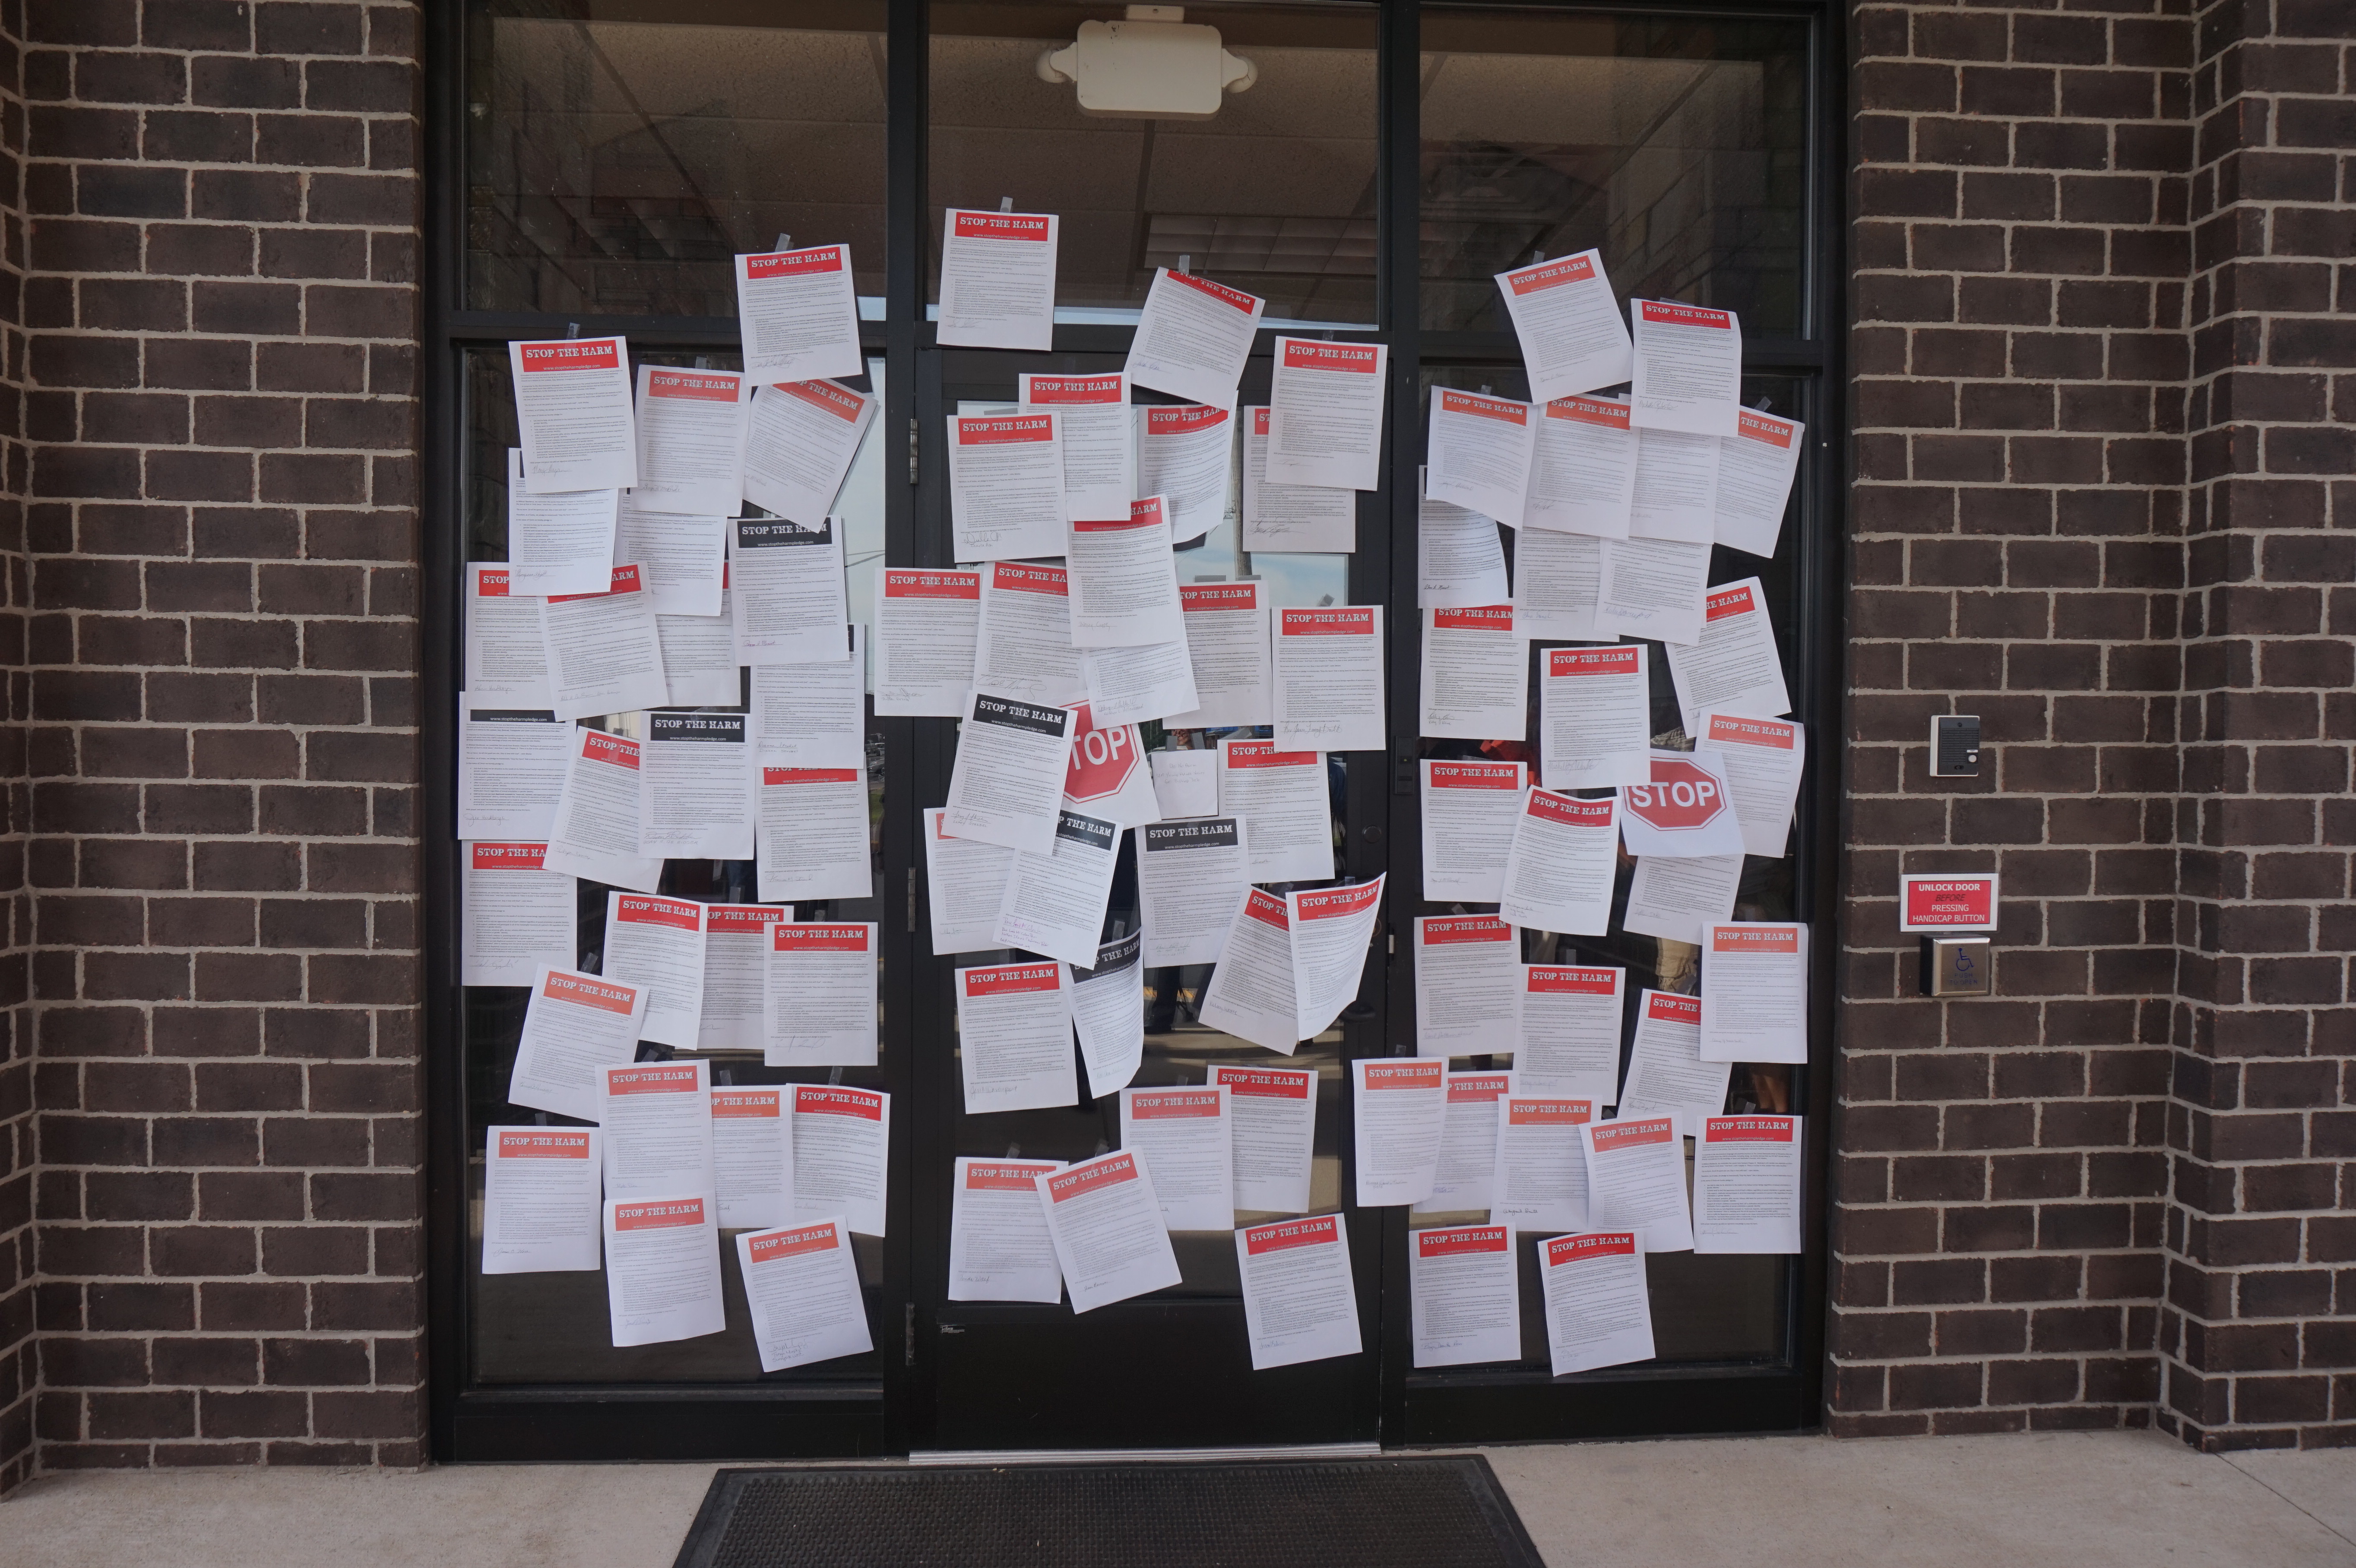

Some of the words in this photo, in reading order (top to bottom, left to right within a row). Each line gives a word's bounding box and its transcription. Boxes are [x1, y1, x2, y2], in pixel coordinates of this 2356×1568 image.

[960, 217, 987, 226] STOP
[989, 219, 1010, 228] THE
[1012, 220, 1044, 229] HARM
[751, 258, 778, 268] STOP
[780, 256, 802, 265] THE
[804, 252, 836, 262] HARM
[1513, 274, 1536, 285] STOP
[1538, 268, 1558, 278] THE
[1558, 261, 1588, 274] HARM
[526, 349, 554, 358] STOP
[557, 348, 580, 357] THE
[581, 345, 613, 356] HARM
[1289, 345, 1315, 356] STOP
[1317, 348, 1339, 358] THE
[1341, 350, 1373, 360] HARM
[654, 376, 680, 386] STOP
[682, 379, 703, 388] THE
[705, 380, 735, 389] HARM
[1034, 382, 1061, 391] STOP
[1063, 382, 1085, 392] THE
[1087, 381, 1117, 391] HARM
[1446, 395, 1471, 405] STOP
[1472, 400, 1492, 409] THE
[1494, 405, 1523, 415] HARM
[963, 423, 989, 431] STOP
[991, 422, 1013, 431] THE
[1015, 420, 1047, 430] HARM
[742, 526, 769, 535] STOP
[771, 525, 793, 534] THE
[890, 575, 917, 584] STOP
[919, 576, 940, 585] THE
[943, 577, 975, 586] HARM
[1286, 614, 1312, 623] STOP
[1314, 614, 1335, 623] THE
[1337, 613, 1369, 622] HARM
[1553, 655, 1577, 664] STOP
[1579, 654, 1600, 663] THE
[1602, 652, 1634, 662] HARM
[979, 700, 1006, 712] STOP
[1008, 705, 1029, 718] THE
[1031, 710, 1062, 724] HARM
[655, 719, 682, 728] STOP
[684, 720, 706, 729] THE
[709, 721, 741, 730] HARM
[991, 719, 1047, 733] www.stoptheharmpledge.com
[1713, 720, 1738, 730] STOP
[1741, 723, 1760, 733] THE
[1761, 726, 1790, 737] HARM
[1071, 726, 1126, 770] TOP
[1434, 767, 1459, 775] STOP
[1461, 768, 1481, 776] THE
[1483, 768, 1514, 777] HARM
[1632, 781, 1715, 807] STOP
[1533, 796, 1558, 808] STOP
[1560, 803, 1580, 814] THE
[1581, 806, 1610, 815] HARM
[1543, 815, 1596, 826] www.stoptheharmpledge.com
[1149, 828, 1175, 838] STOP
[1178, 827, 1199, 836] THE
[1200, 824, 1232, 835] HARM
[1302, 897, 1328, 907] STOP
[1331, 894, 1352, 904] THE
[1355, 885, 1378, 901] HARM
[623, 900, 650, 910] STOP
[652, 903, 672, 913] THE
[673, 906, 697, 917] HARM
[1317, 905, 1368, 918] www.stoptheharmpledge.com
[969, 973, 996, 983] STOP
[998, 971, 1020, 981] THE
[1022, 968, 1054, 979] HARM
[1532, 971, 1557, 980] STOP
[1559, 972, 1579, 981] THE
[1581, 973, 1612, 982] HARM
[612, 1074, 639, 1083] STOP
[641, 1072, 661, 1081] THE
[663, 1071, 693, 1080] HARM
[1222, 1073, 1248, 1083] STOP
[1250, 1075, 1271, 1084] THE
[1273, 1076, 1304, 1086] HARM
[1368, 1069, 1393, 1077] STOP
[1395, 1069, 1414, 1077] THE
[1416, 1068, 1438, 1076] HARM
[800, 1091, 827, 1100] STOP
[829, 1093, 850, 1103] THE
[852, 1095, 878, 1107] HARM
[1136, 1098, 1161, 1107] STOP
[1163, 1097, 1184, 1106] THE
[1185, 1096, 1215, 1105] HARM
[1513, 1104, 1537, 1113] STOP
[1539, 1105, 1557, 1113] THE
[1559, 1105, 1587, 1113] HARM
[1595, 1129, 1617, 1140] STOP
[1618, 1126, 1637, 1136] THE
[1639, 1123, 1668, 1133] HARM
[1710, 1122, 1734, 1130] STOP
[1736, 1121, 1755, 1129] THE
[1758, 1121, 1789, 1129] HARM
[532, 1137, 552, 1145] THE
[554, 1138, 585, 1146] HARM
[1053, 1176, 1077, 1190] STOP
[1079, 1168, 1099, 1181] THE
[1100, 1159, 1130, 1174] HARM
[619, 1208, 644, 1218] STOP
[646, 1207, 666, 1216] THE
[668, 1204, 699, 1214] HARM
[1250, 1230, 1276, 1242] STOP
[1278, 1226, 1299, 1237] THE
[1301, 1221, 1332, 1233] HARM
[1423, 1235, 1448, 1245] STOP
[1450, 1233, 1470, 1242] THE
[1472, 1231, 1502, 1240] HARM
[753, 1239, 778, 1250] STOP
[780, 1234, 801, 1245] THE
[802, 1228, 832, 1241] HARM
[1552, 1242, 1575, 1253] STOP
[1577, 1238, 1597, 1248] THE
